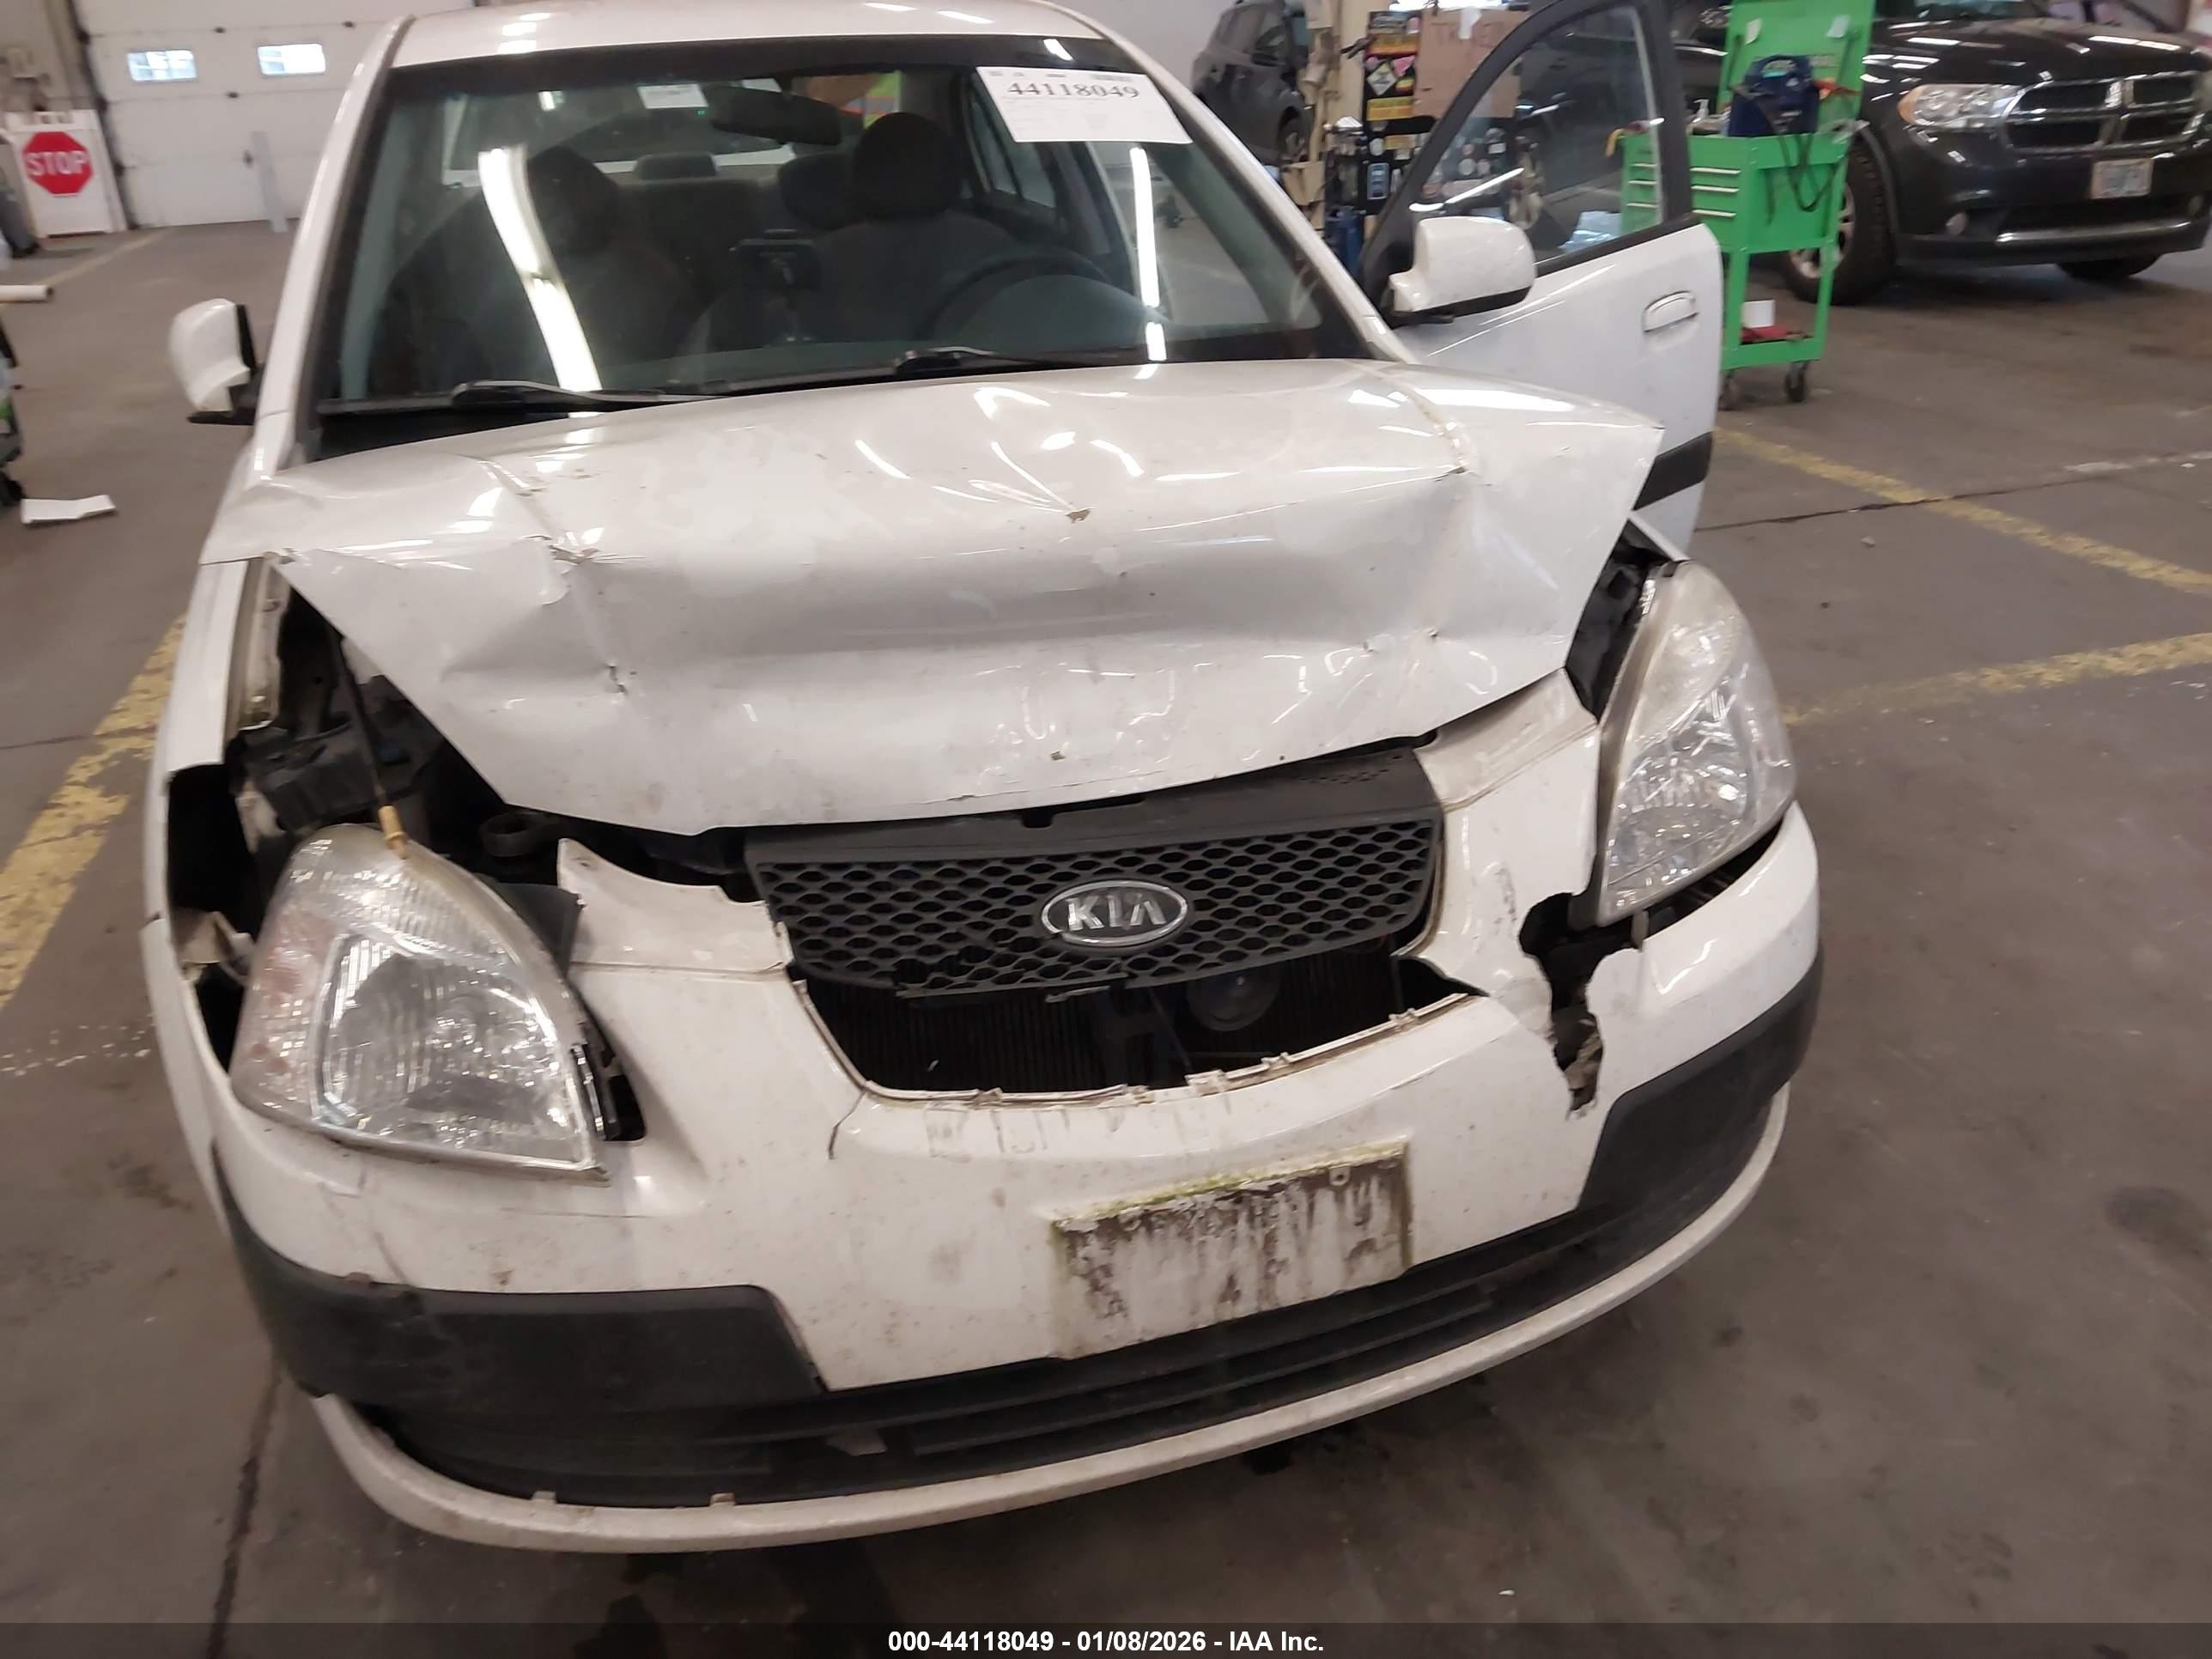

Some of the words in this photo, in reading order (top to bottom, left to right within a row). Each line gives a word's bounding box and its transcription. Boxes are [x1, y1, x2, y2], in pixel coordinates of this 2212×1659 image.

[1008, 82, 1140, 98] 44118049
[26, 150, 88, 176] STOP
[1066, 893, 1167, 932] KIA
